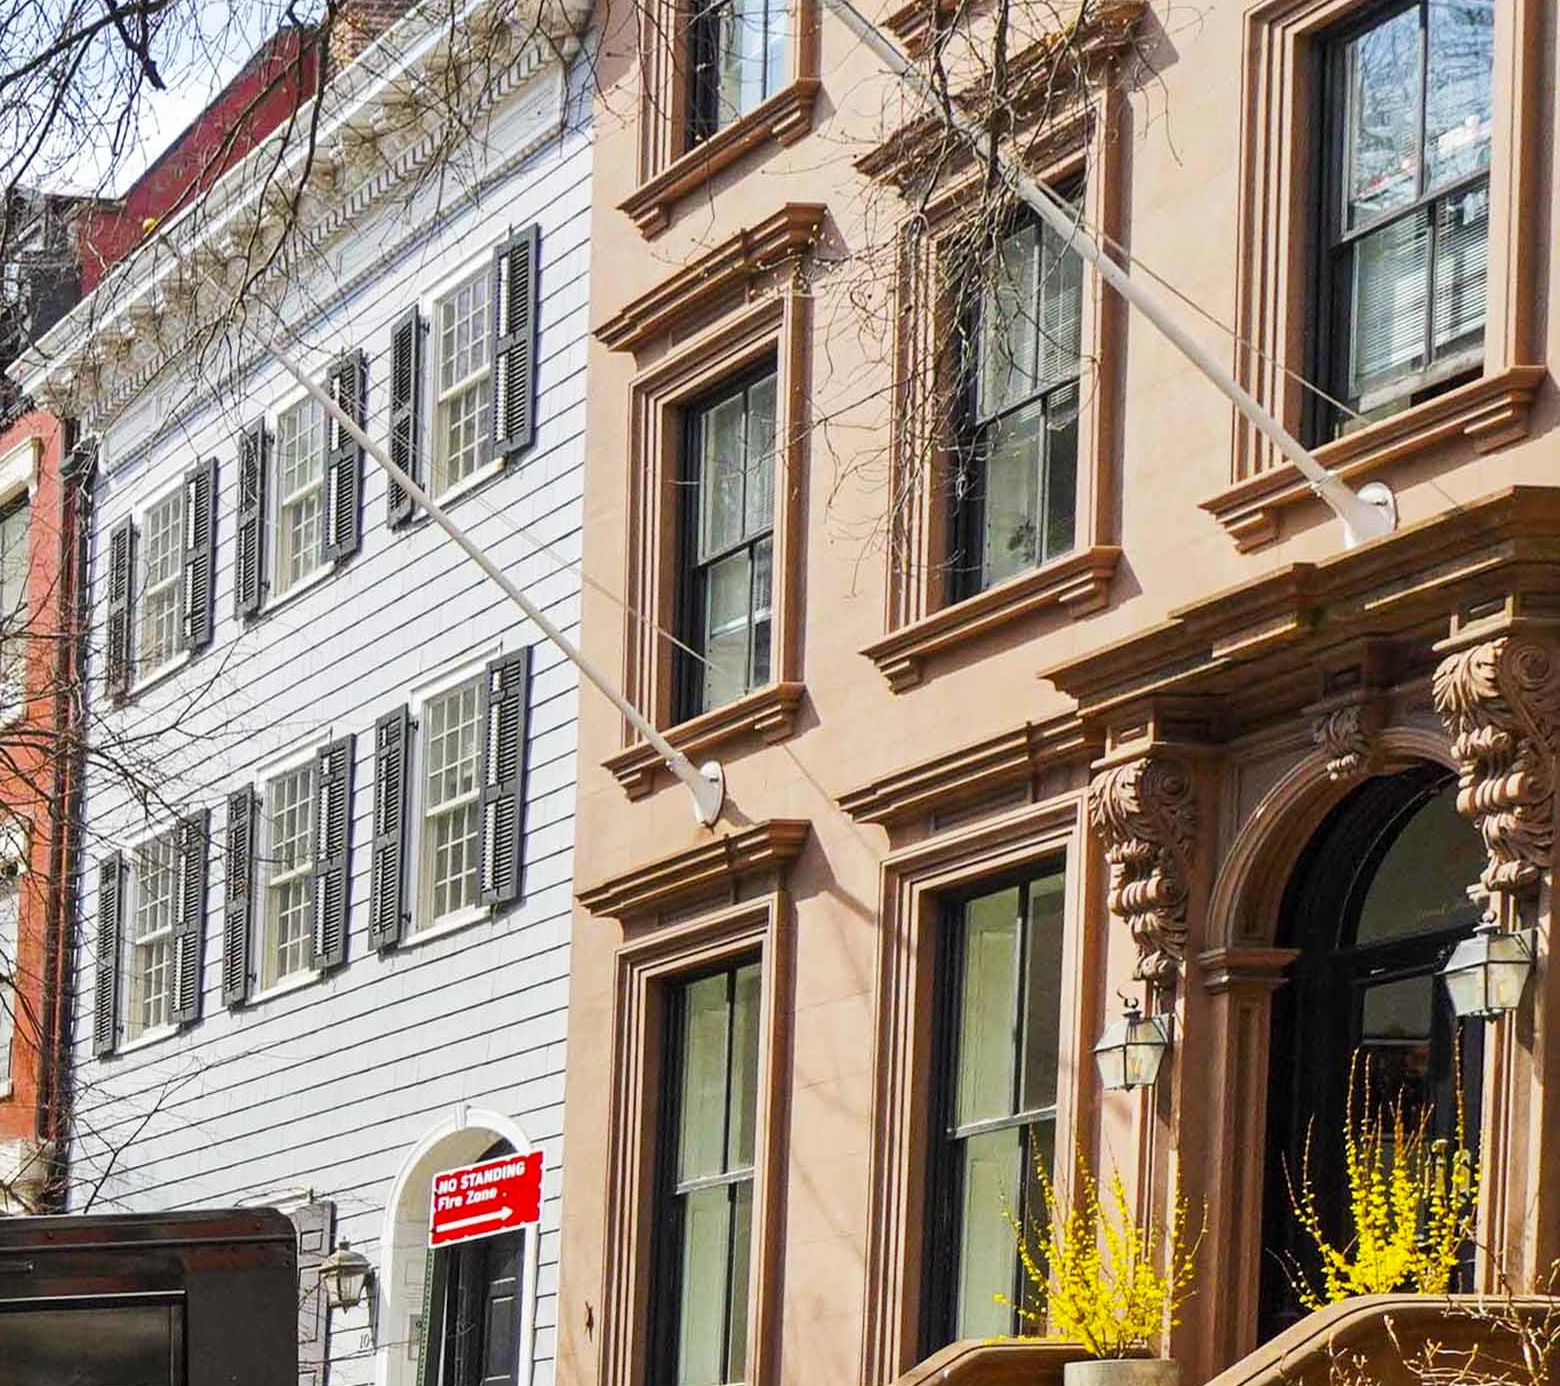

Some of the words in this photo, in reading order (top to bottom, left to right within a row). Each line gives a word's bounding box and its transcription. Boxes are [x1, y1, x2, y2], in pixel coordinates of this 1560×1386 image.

[438, 1178, 457, 1194] NO
[460, 1161, 525, 1189] STANDING
[437, 1195, 463, 1211] Fire
[466, 1187, 498, 1205] Zone
